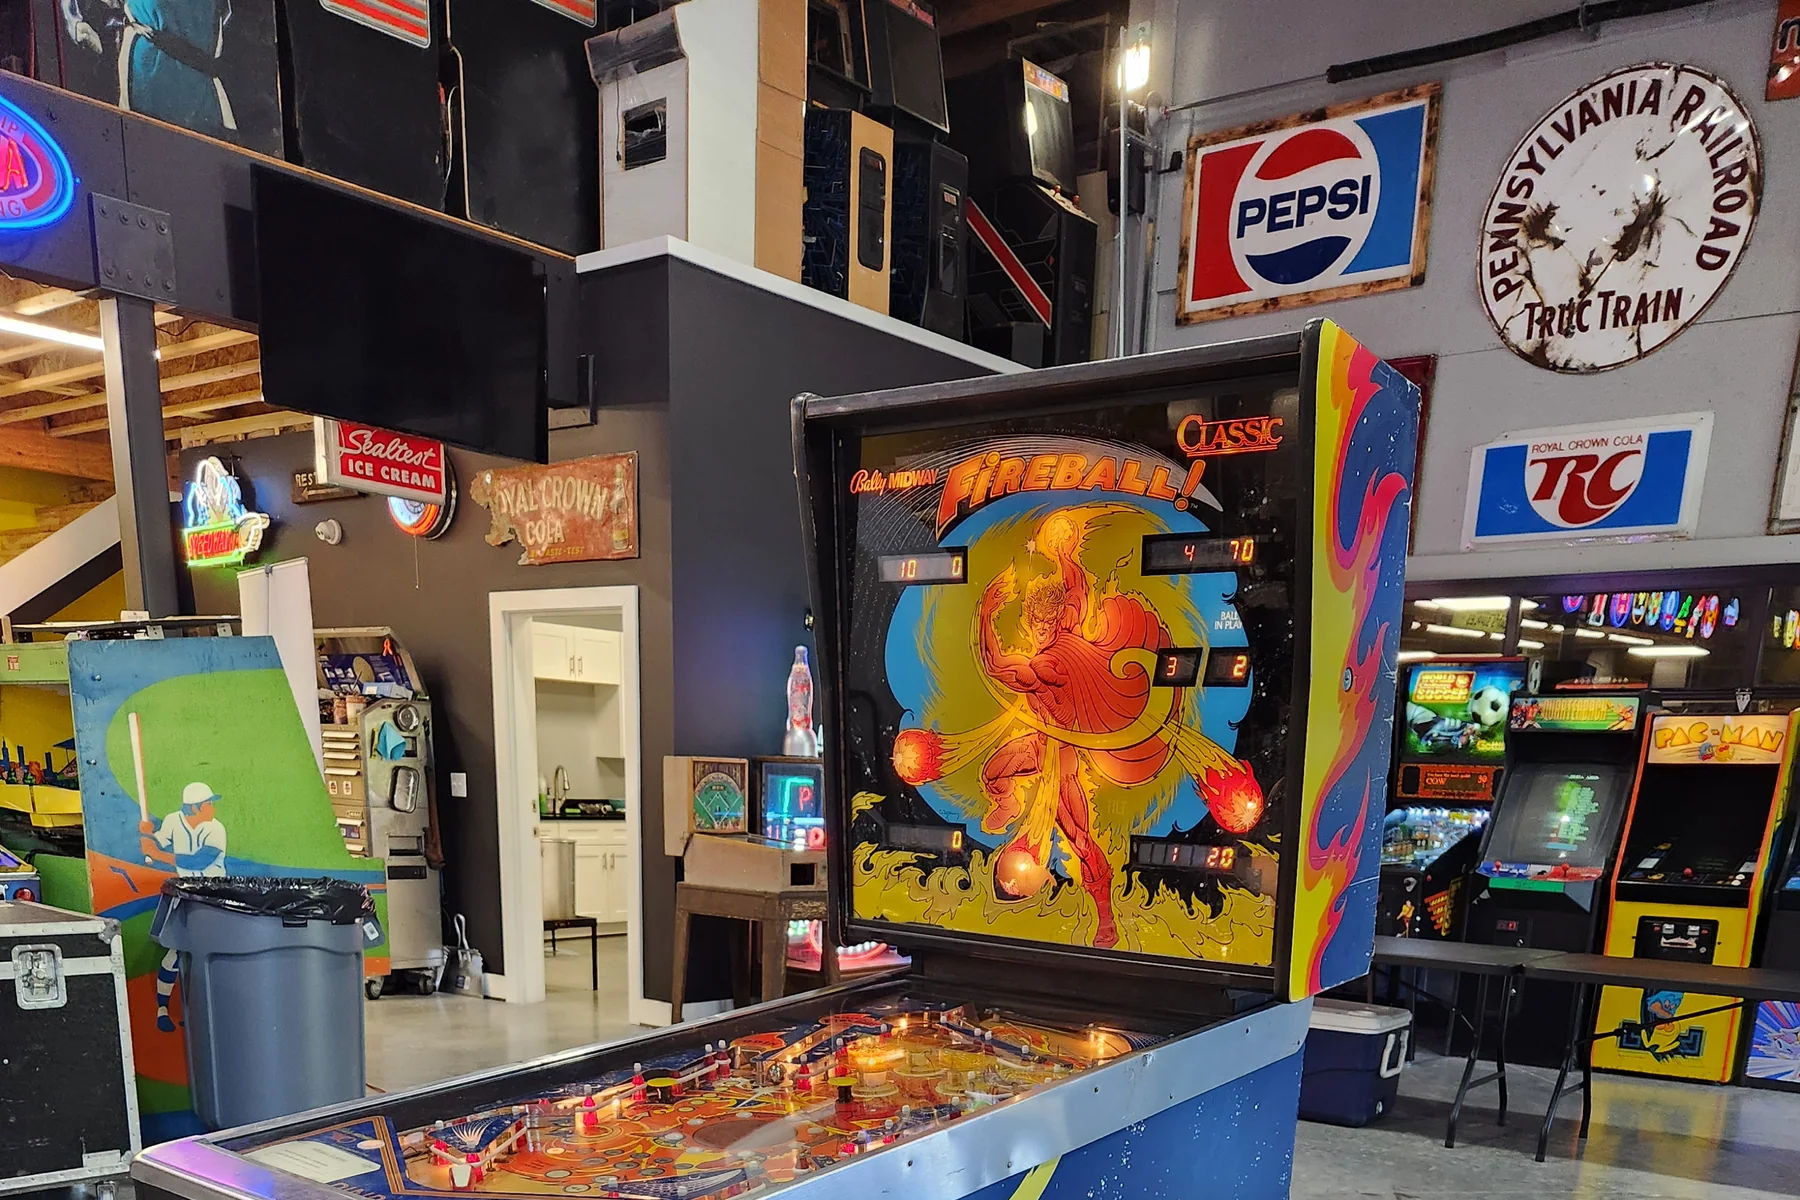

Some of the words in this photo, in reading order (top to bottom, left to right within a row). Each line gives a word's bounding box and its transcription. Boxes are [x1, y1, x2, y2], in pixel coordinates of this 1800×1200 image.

[1489, 79, 1663, 302] PENNSYLVANIA
[1671, 85, 1748, 271] RAILROAD
[1237, 175, 1371, 239] PEPSI
[1597, 287, 1683, 330] TRAIN
[1176, 414, 1284, 453] CLASSIC
[1532, 443, 1564, 453] ROYAL
[1568, 438, 1609, 450] CROWN
[1613, 434, 1643, 446] COLA
[340, 430, 441, 470] Sealtest
[348, 459, 374, 477] ICE
[380, 465, 436, 489] CREAM
[850, 469, 887, 496] Bally
[889, 468, 939, 489] MIDWAY
[1529, 450, 1641, 524] RC
[496, 479, 538, 516] OYAL
[541, 475, 609, 521] CROWN
[525, 519, 565, 546] COLA
[1184, 544, 1195, 562] 4
[1230, 539, 1254, 562] 70
[901, 560, 916, 578] 10
[952, 556, 963, 576] 0
[1214, 621, 1223, 630] IN
[1221, 611, 1239, 621] BALL
[1166, 656, 1177, 676] 3
[1233, 655, 1247, 677] 2
[1655, 722, 1784, 753] PAC-MAN
[951, 830, 962, 849] 0
[1207, 846, 1234, 868] 20
